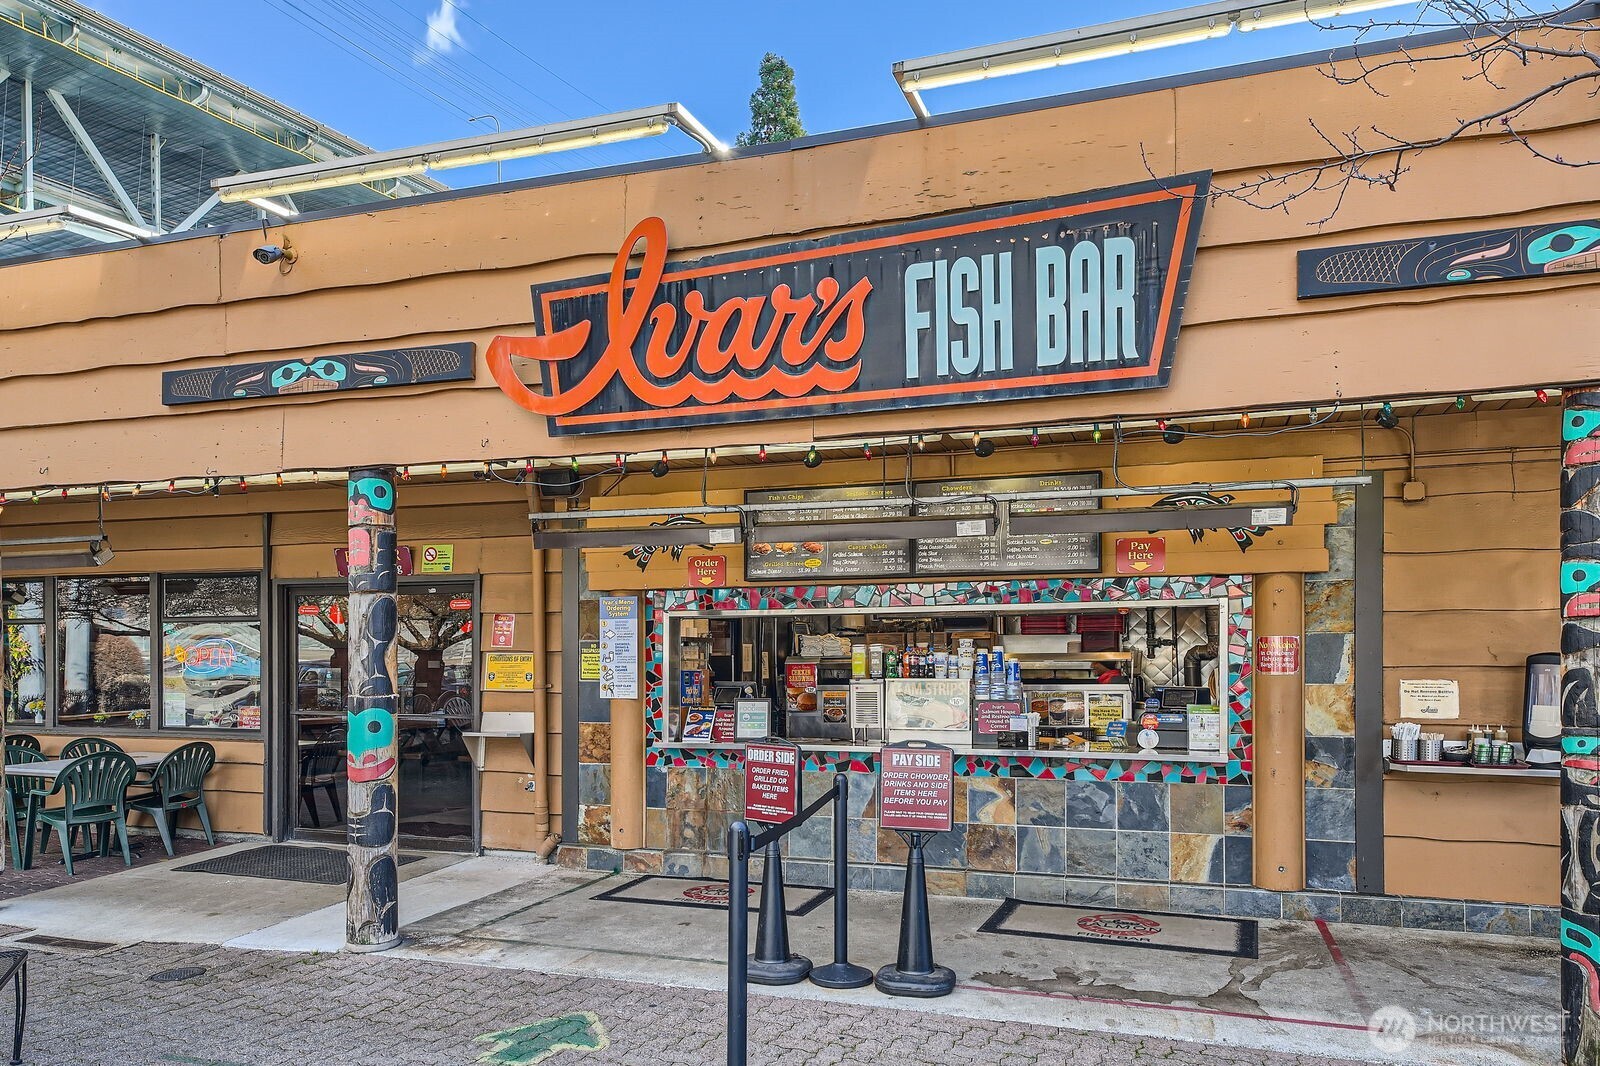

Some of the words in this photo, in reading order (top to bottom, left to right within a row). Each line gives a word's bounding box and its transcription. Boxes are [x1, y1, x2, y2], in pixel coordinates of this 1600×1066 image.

[486, 216, 874, 416] Ivar's
[904, 252, 1015, 380] FISH
[1034, 236, 1141, 368] BAR
[1131, 542, 1151, 552] Pay
[1128, 551, 1154, 560] Here
[694, 559, 719, 567] Order
[1259, 641, 1268, 649] No
[1272, 640, 1297, 649] Alcohol
[184, 646, 234, 667] OPEN
[925, 682, 967, 695] STRIPS
[748, 748, 774, 762] ORDER
[775, 751, 794, 764] SIDE
[892, 754, 914, 766] PAY
[915, 754, 940, 767] SIDE
[752, 766, 772, 774] ORDER
[772, 769, 790, 777] FRIED,
[910, 773, 950, 781] CHOWDER,
[754, 775, 778, 784] GRILLED
[1076, 920, 1162, 932] SALMON
